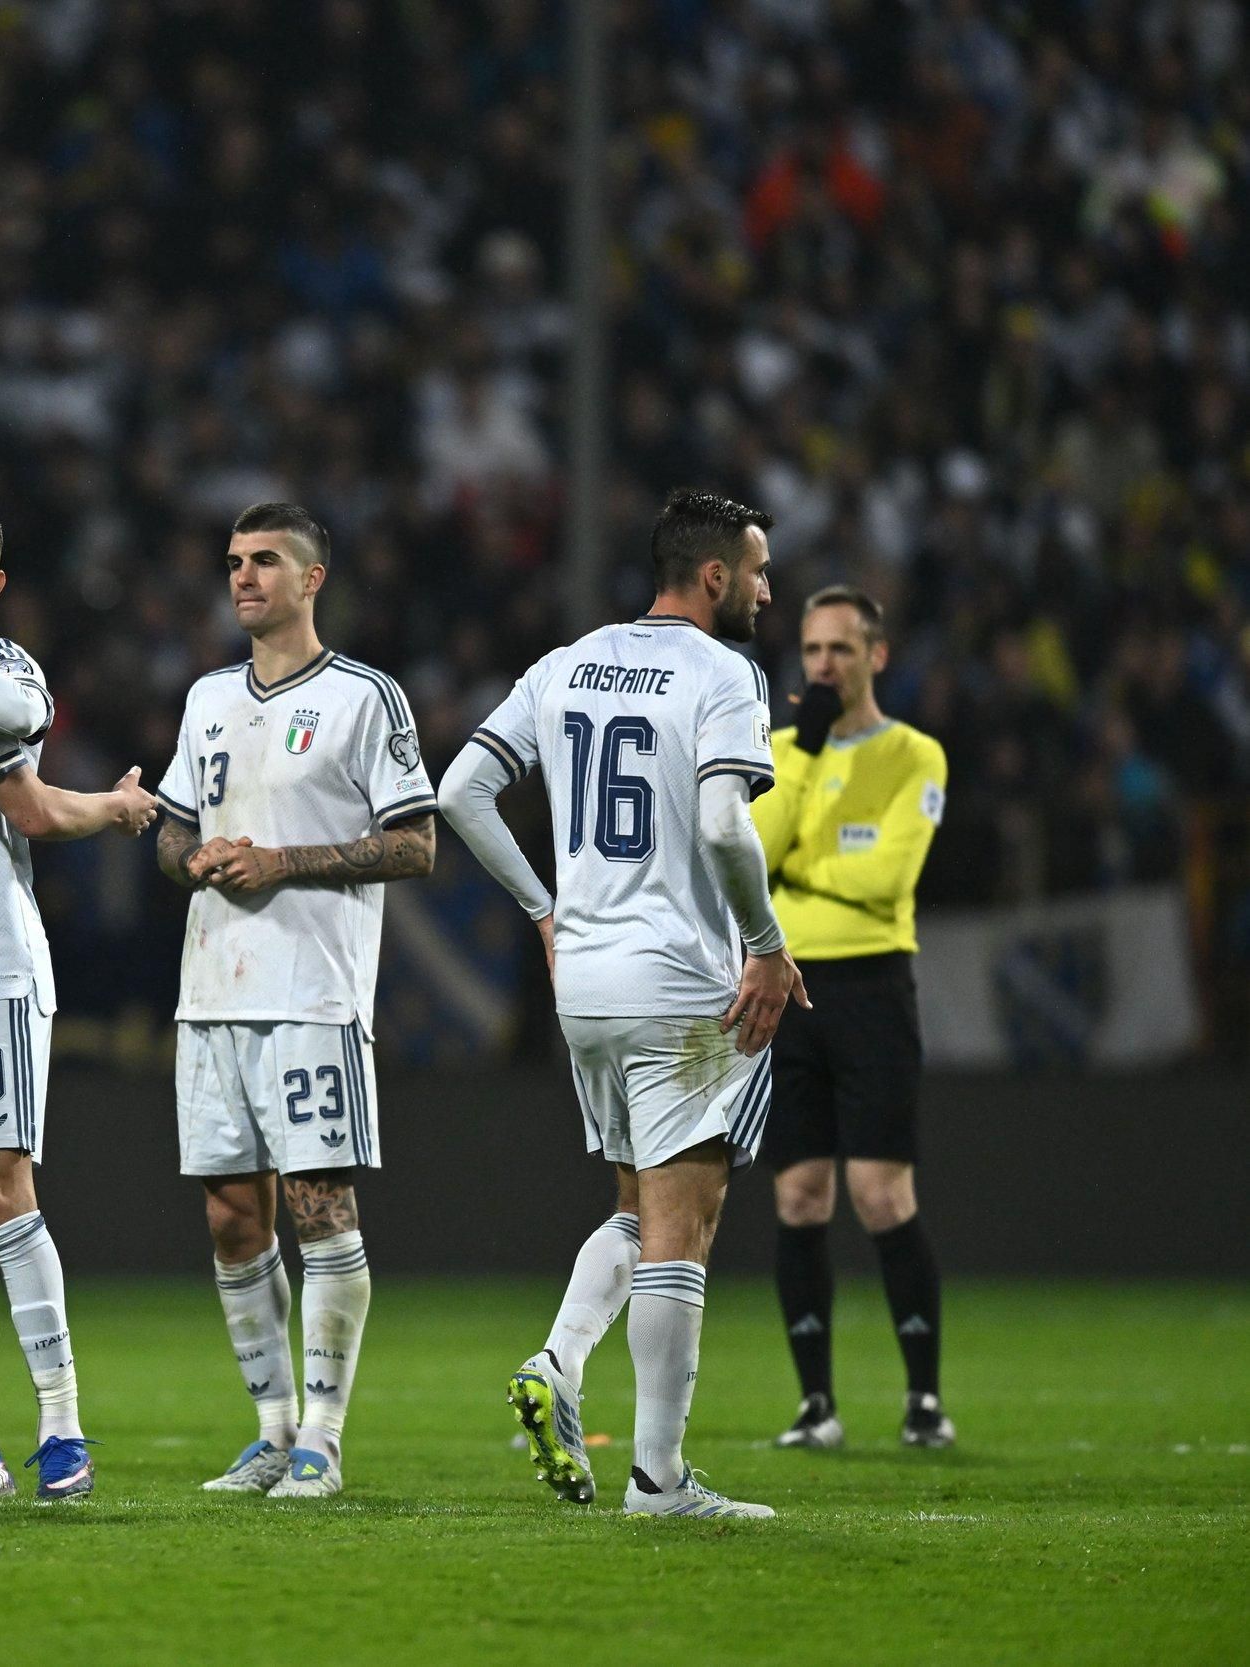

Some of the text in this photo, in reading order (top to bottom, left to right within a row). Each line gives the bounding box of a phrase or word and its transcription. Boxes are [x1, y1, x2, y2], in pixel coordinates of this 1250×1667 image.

[568, 662, 675, 695] CRISTANTE
[292, 717, 315, 728] ITALIA
[564, 711, 658, 864] 16
[283, 1065, 347, 1125] 23
[305, 1348, 346, 1361] ITALIA
